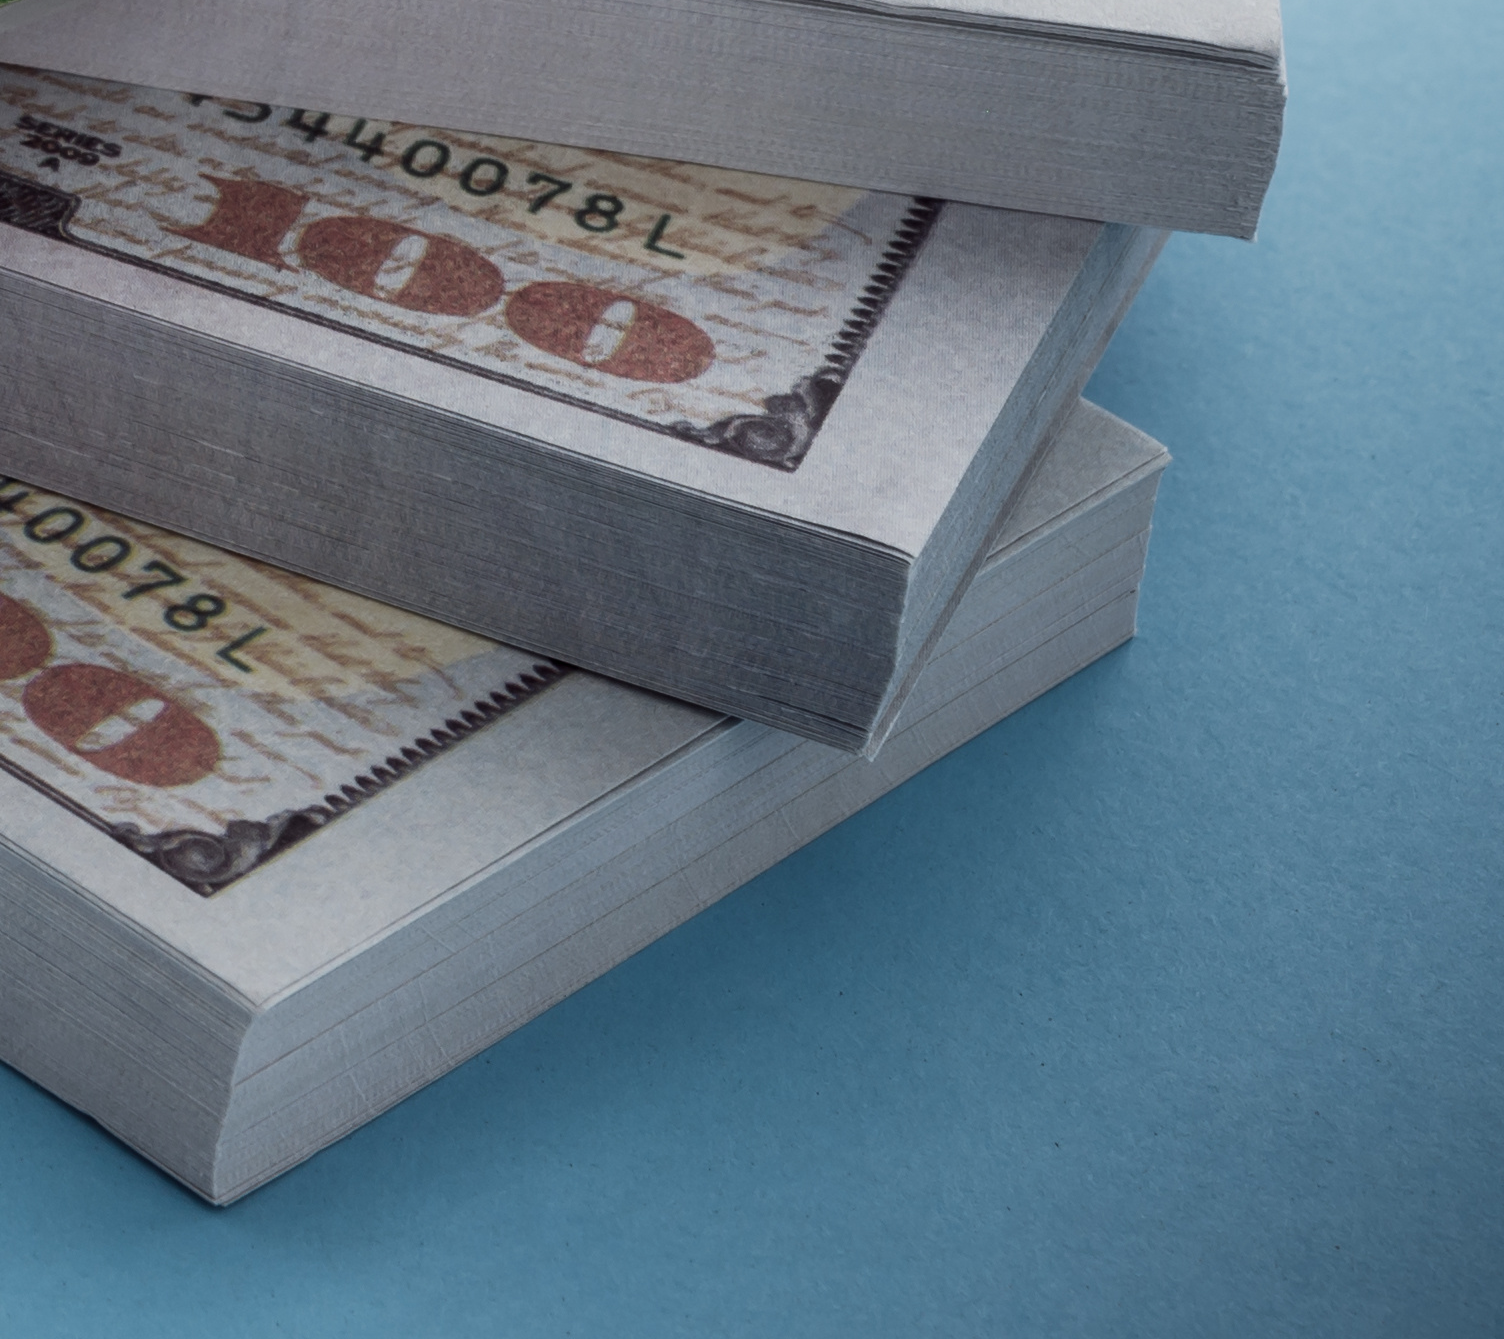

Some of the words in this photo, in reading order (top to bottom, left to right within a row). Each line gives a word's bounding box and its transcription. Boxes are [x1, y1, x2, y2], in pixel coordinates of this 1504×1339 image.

[15, 114, 123, 158] SERIES
[19, 133, 100, 166] 2009
[38, 156, 61, 172] A
[158, 171, 717, 385] 100
